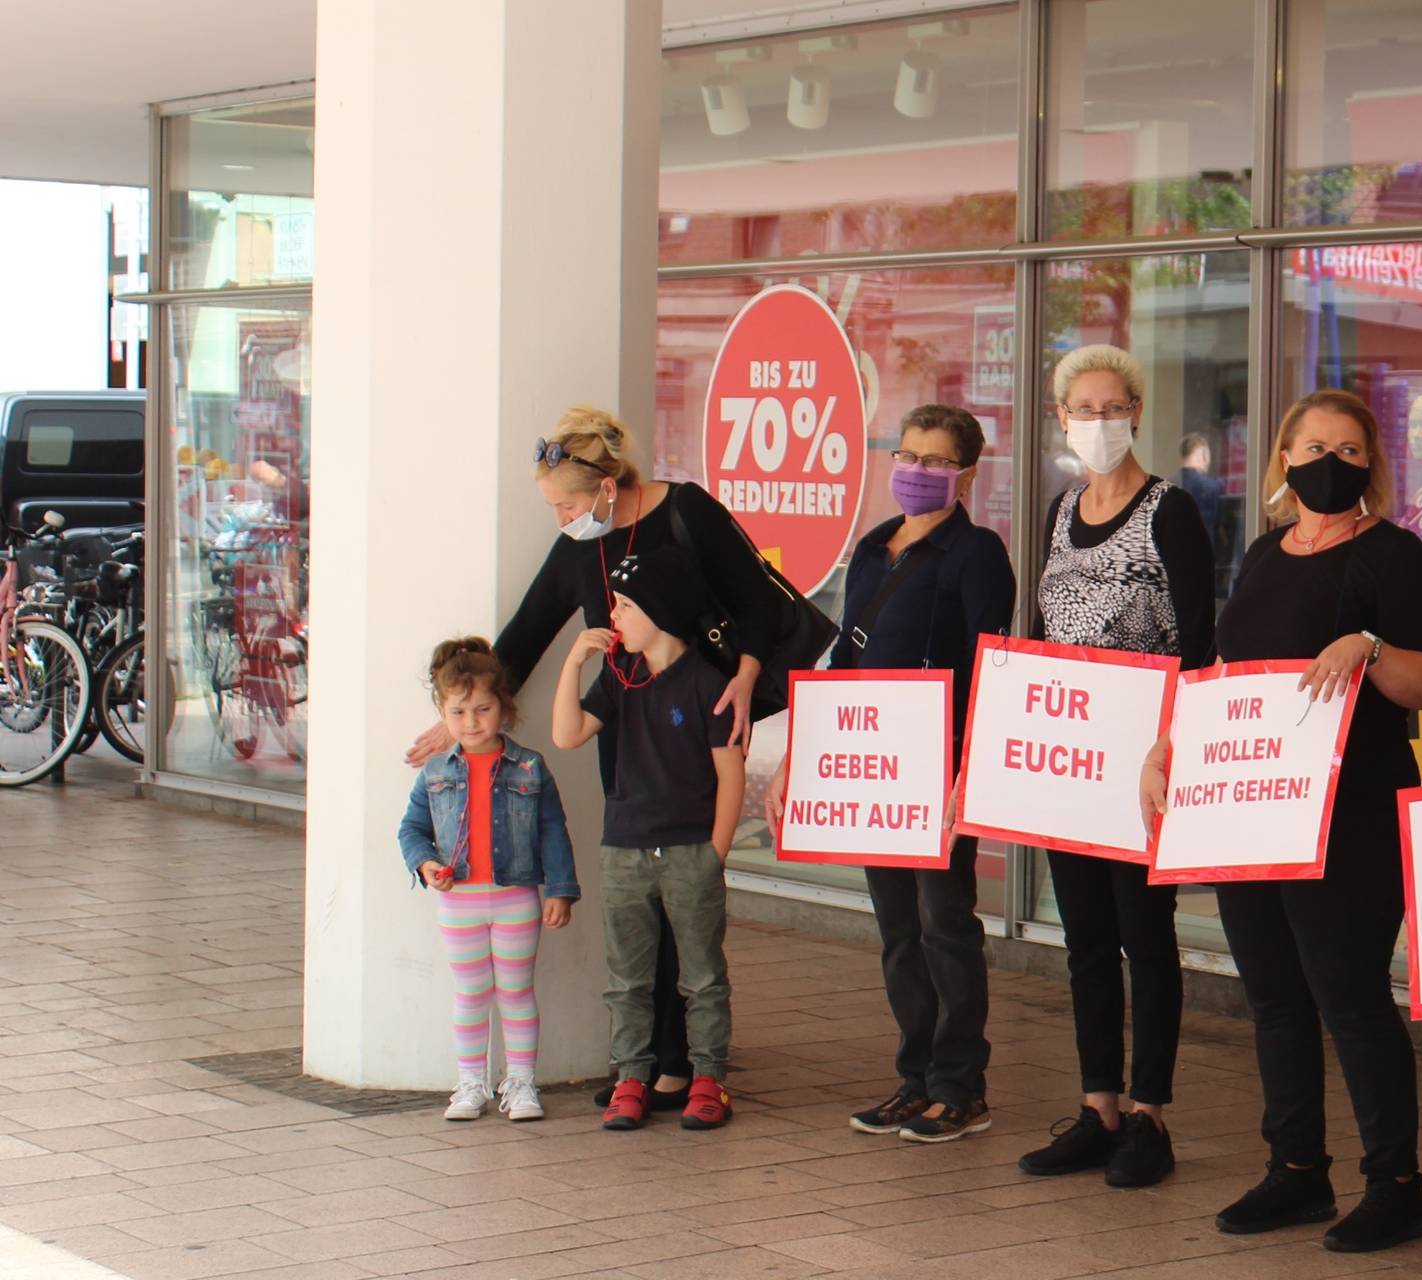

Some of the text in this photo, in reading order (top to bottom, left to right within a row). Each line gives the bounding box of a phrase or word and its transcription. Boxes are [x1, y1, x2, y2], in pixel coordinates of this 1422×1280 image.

[749, 360, 817, 389] BIS ZU
[719, 396, 848, 475] 70%
[718, 479, 846, 517] REDUZIERT
[1025, 680, 1091, 722] FÜR
[1226, 696, 1264, 721] WIR
[837, 705, 880, 732] WIR
[817, 752, 899, 781] GEBEN
[1003, 736, 1106, 783] EUCH!
[1203, 736, 1283, 765] WOLLEN
[1173, 776, 1312, 808] NICHT GEHEN!
[789, 799, 930, 831] NICHT AUF!
